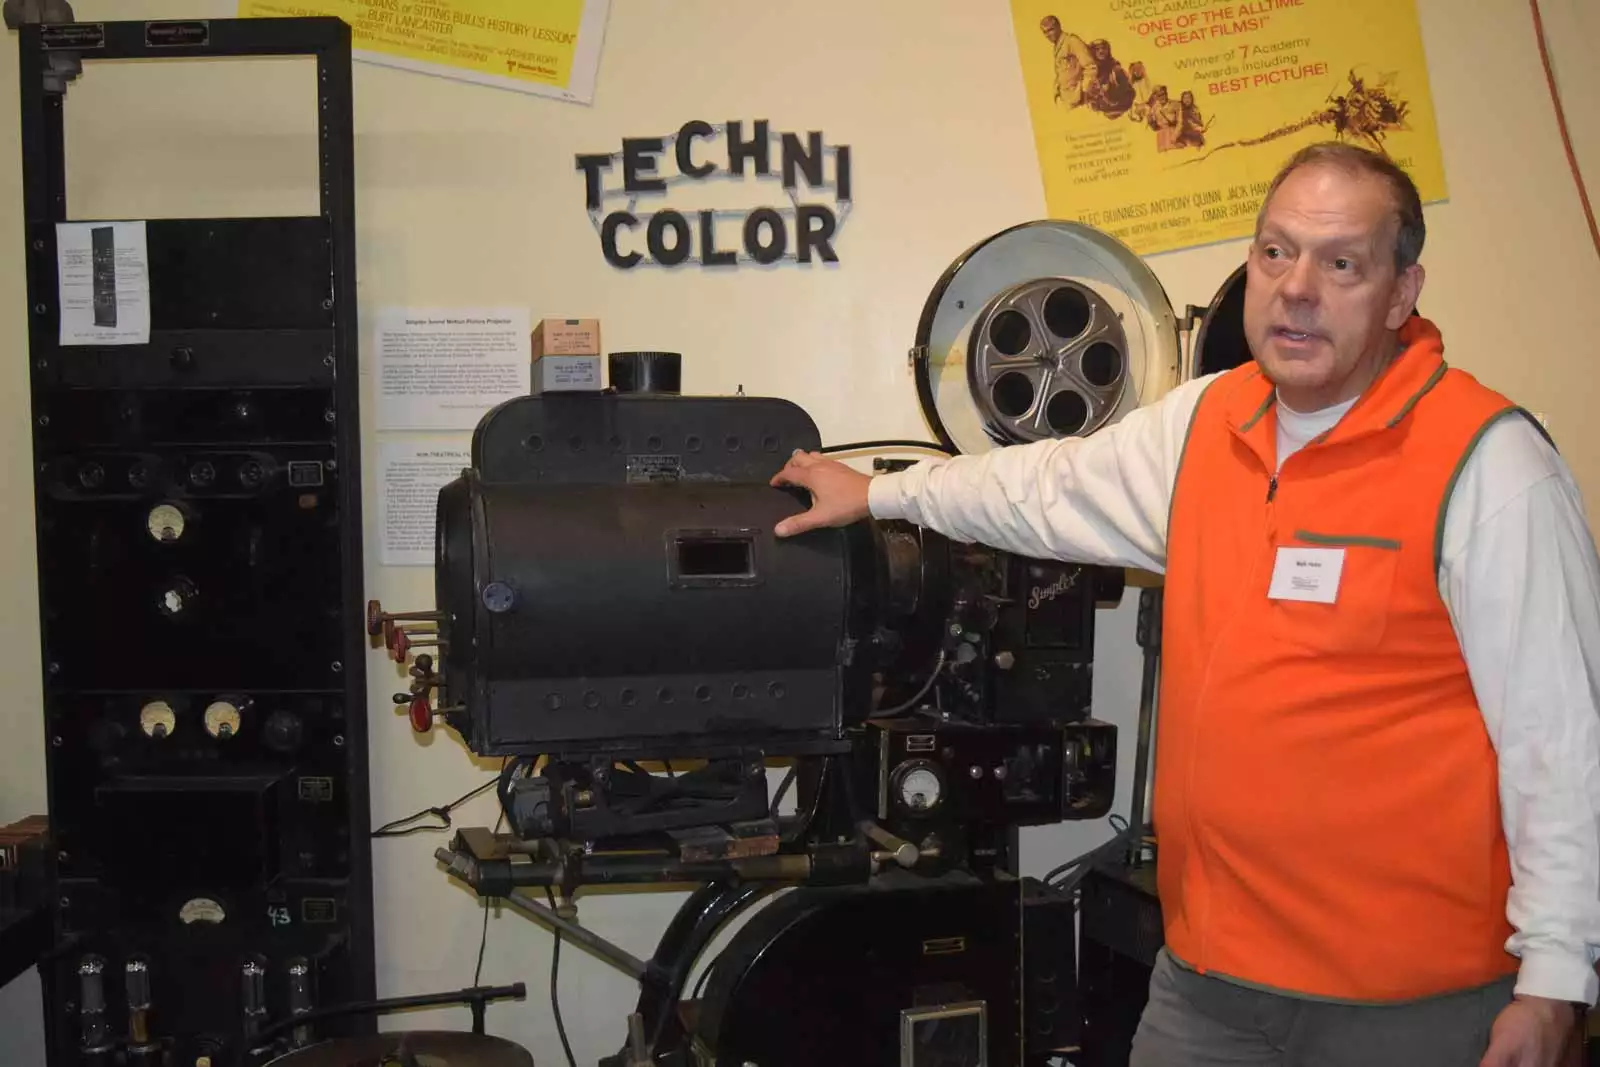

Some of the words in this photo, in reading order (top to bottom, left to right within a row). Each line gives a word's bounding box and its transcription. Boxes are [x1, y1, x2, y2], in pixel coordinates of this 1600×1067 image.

[1123, 0, 1207, 20] ACCLAIMED
[1176, 13, 1199, 28] OF
[1201, 6, 1234, 23] THE
[396, 15, 453, 34] LANCASTER
[487, 18, 529, 37] HISTORY
[1154, 27, 1208, 48] GREAT
[1174, 53, 1220, 70] Winner
[1223, 50, 1236, 62] of
[1238, 44, 1250, 60] 7
[1252, 37, 1312, 55] Academy
[1194, 67, 1240, 82] Awards
[1242, 53, 1299, 72] including
[1208, 77, 1250, 95] BEST
[1253, 62, 1329, 88] PICTURE!
[575, 119, 852, 210] TECHNI
[1103, 202, 1148, 224] GUINNESS
[1150, 194, 1191, 216] ANTHONY
[1193, 188, 1221, 209] QUINN
[1227, 184, 1249, 201] JACK
[1249, 180, 1273, 197] HAW
[1202, 206, 1228, 222] OMAR
[601, 204, 839, 269] COLOR
[1028, 566, 1082, 609] Simplex
[266, 904, 292, 928] 43
